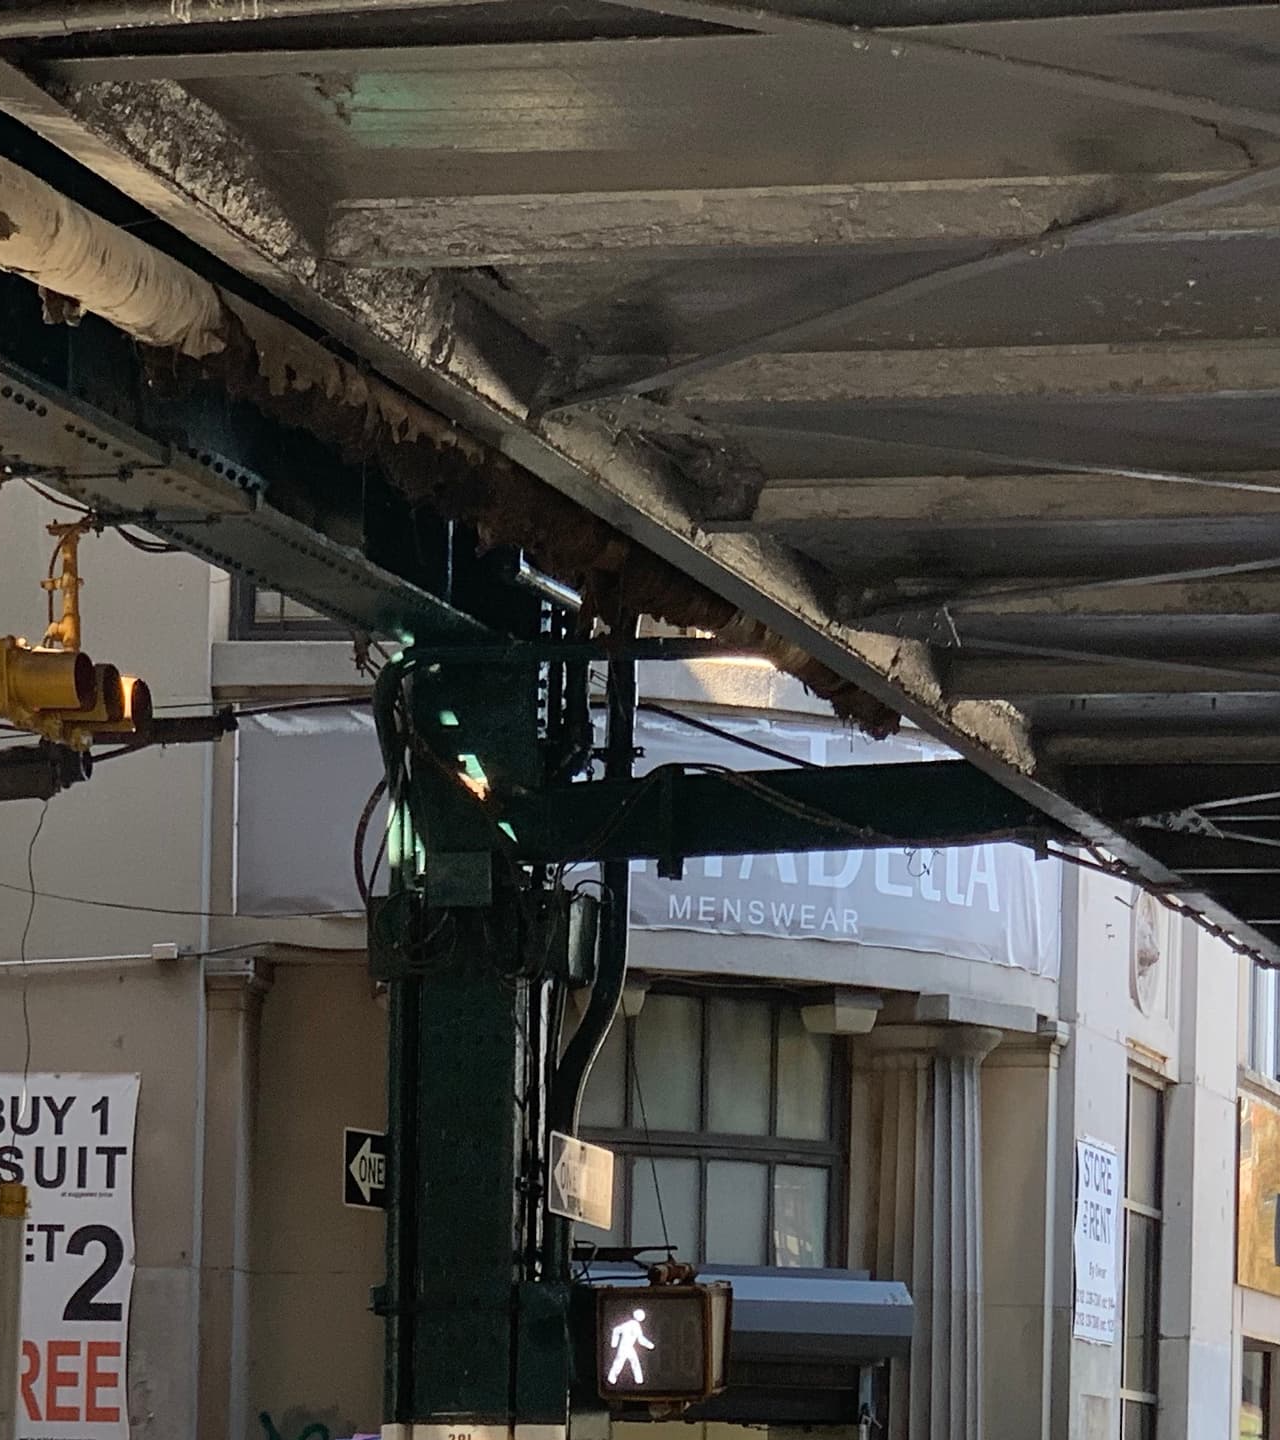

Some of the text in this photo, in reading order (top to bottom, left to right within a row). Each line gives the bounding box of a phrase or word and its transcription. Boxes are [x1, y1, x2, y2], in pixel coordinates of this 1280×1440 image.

[668, 893, 860, 935] MENSWEAR
[91, 1096, 109, 1136] 1
[1083, 1150, 1113, 1196] STORE
[1088, 1200, 1113, 1245] RENT
[63, 1224, 125, 1322] 2
